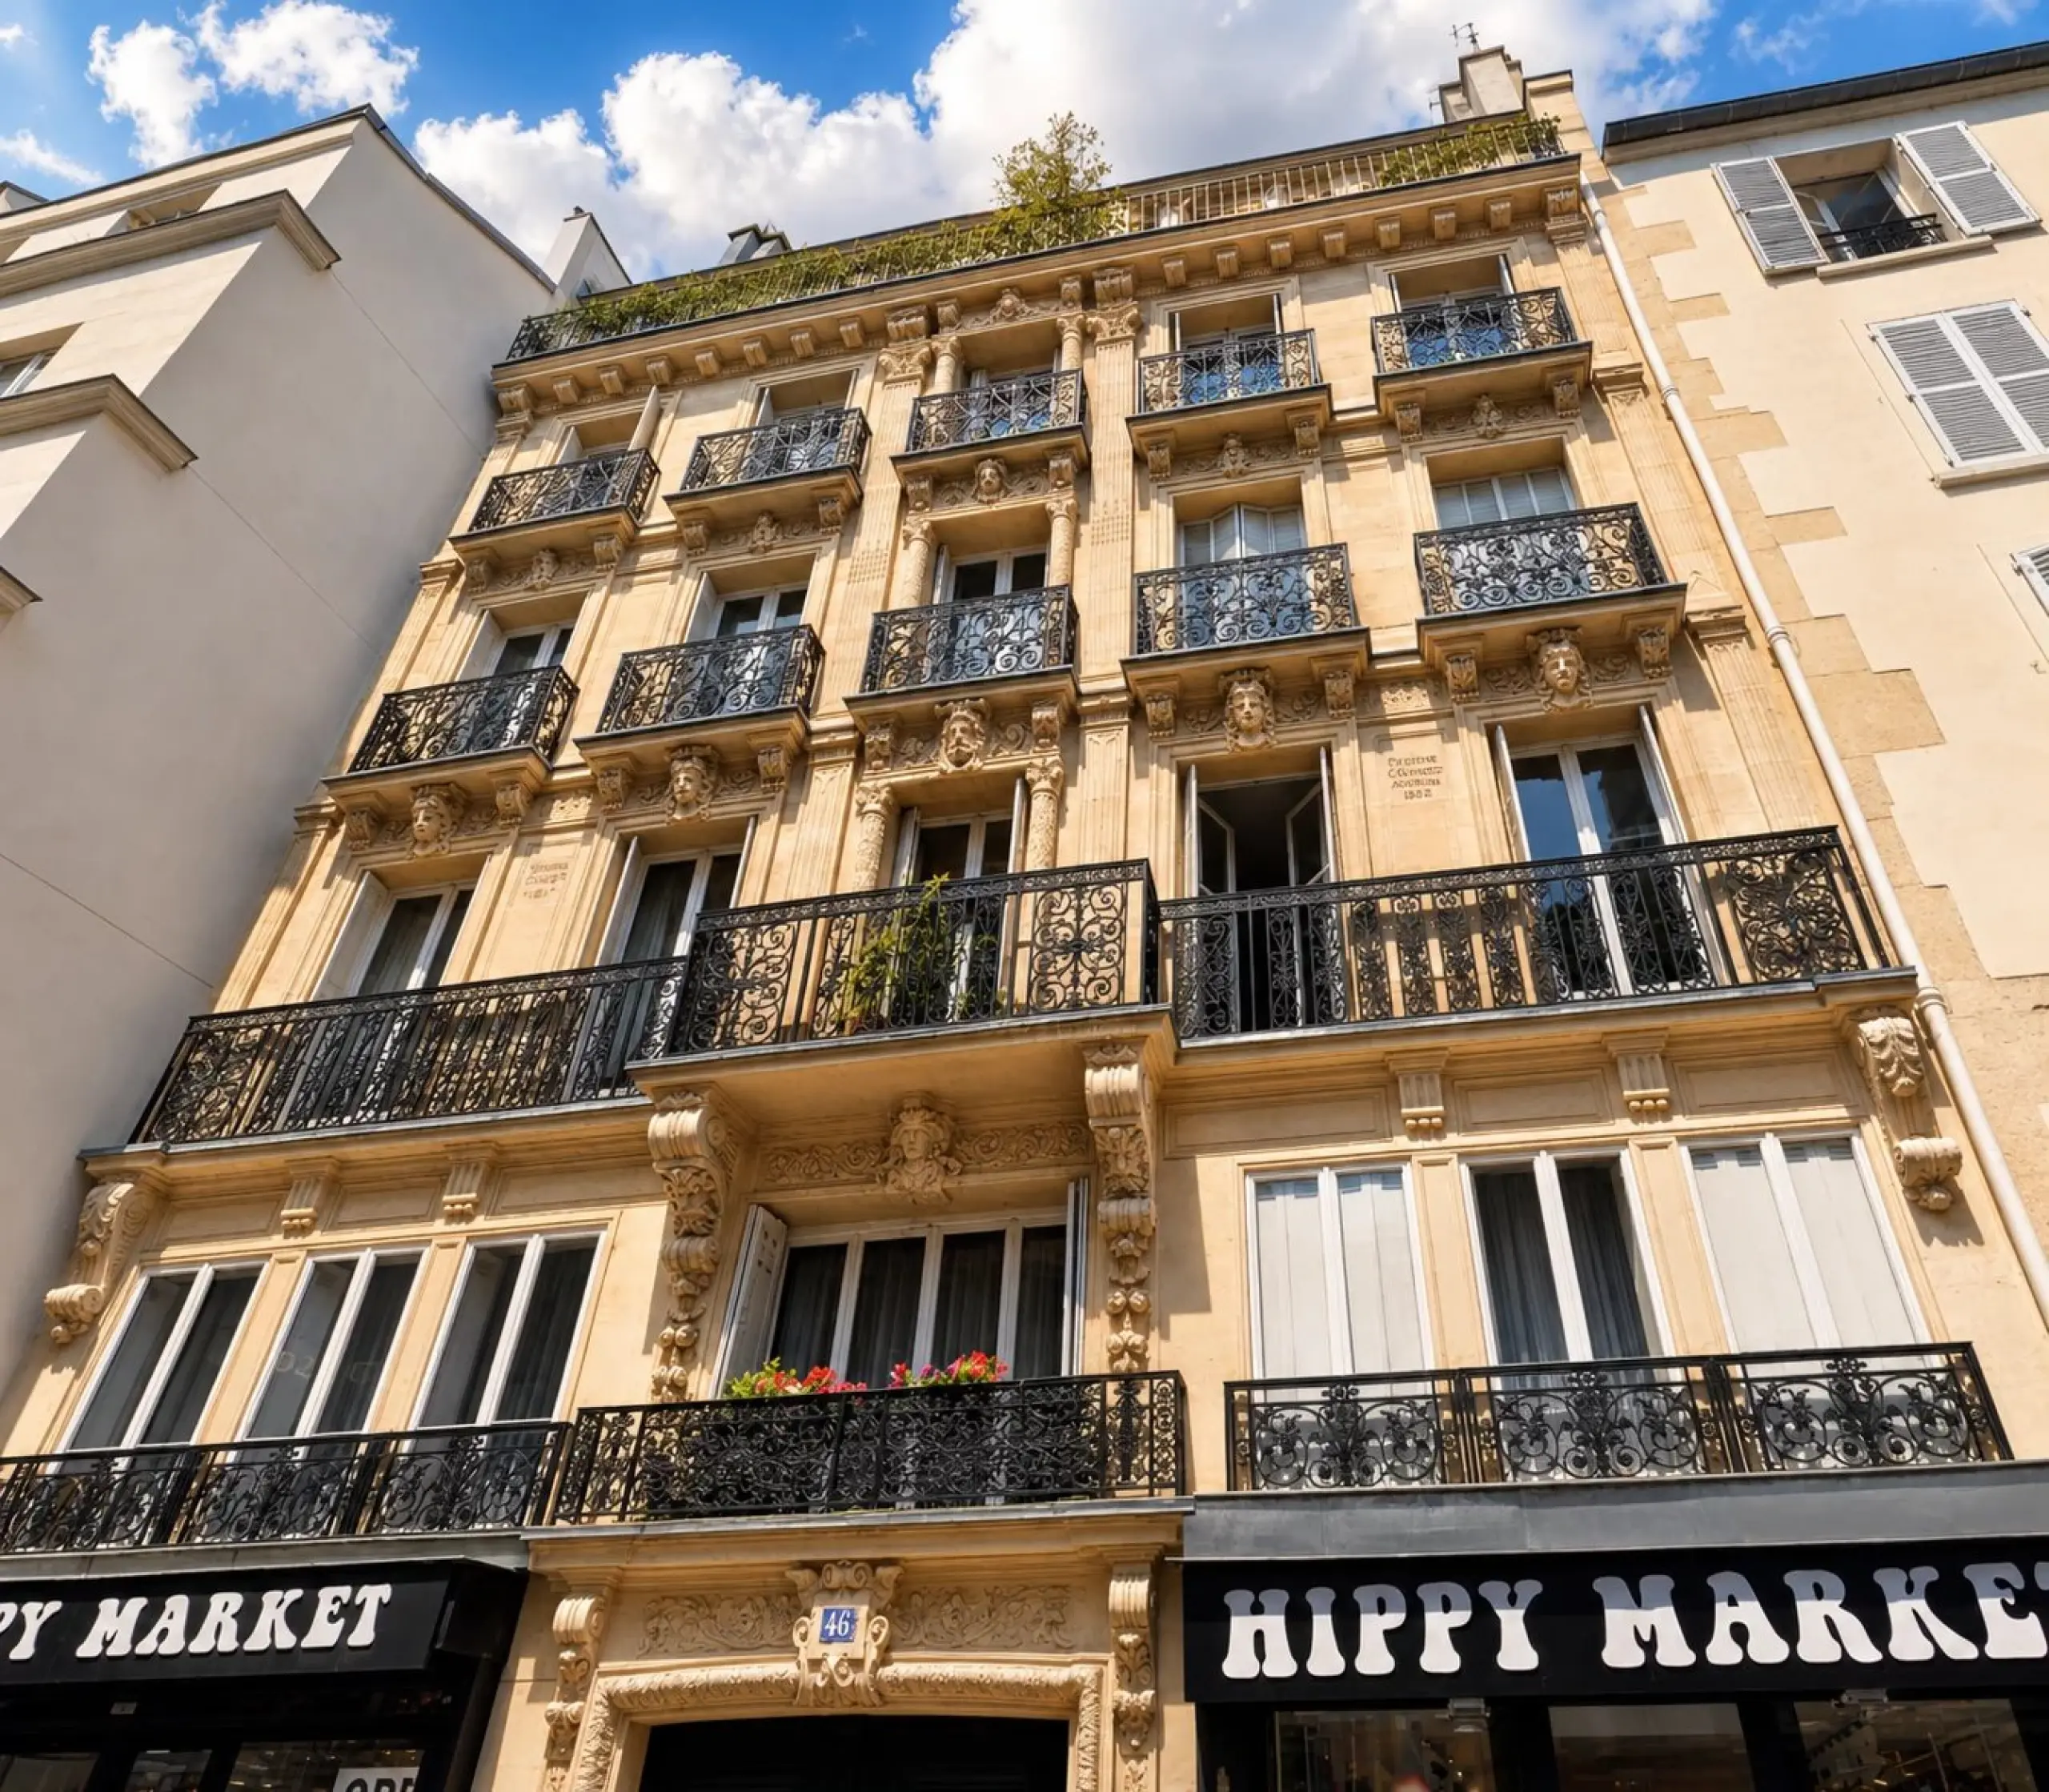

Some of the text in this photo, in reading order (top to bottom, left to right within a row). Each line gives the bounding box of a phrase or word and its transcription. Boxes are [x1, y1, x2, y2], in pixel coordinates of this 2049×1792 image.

[76, 1584, 391, 1658] MARKET
[824, 1610, 851, 1637] 46
[1222, 1561, 2049, 1679] HIPPY MARKE
